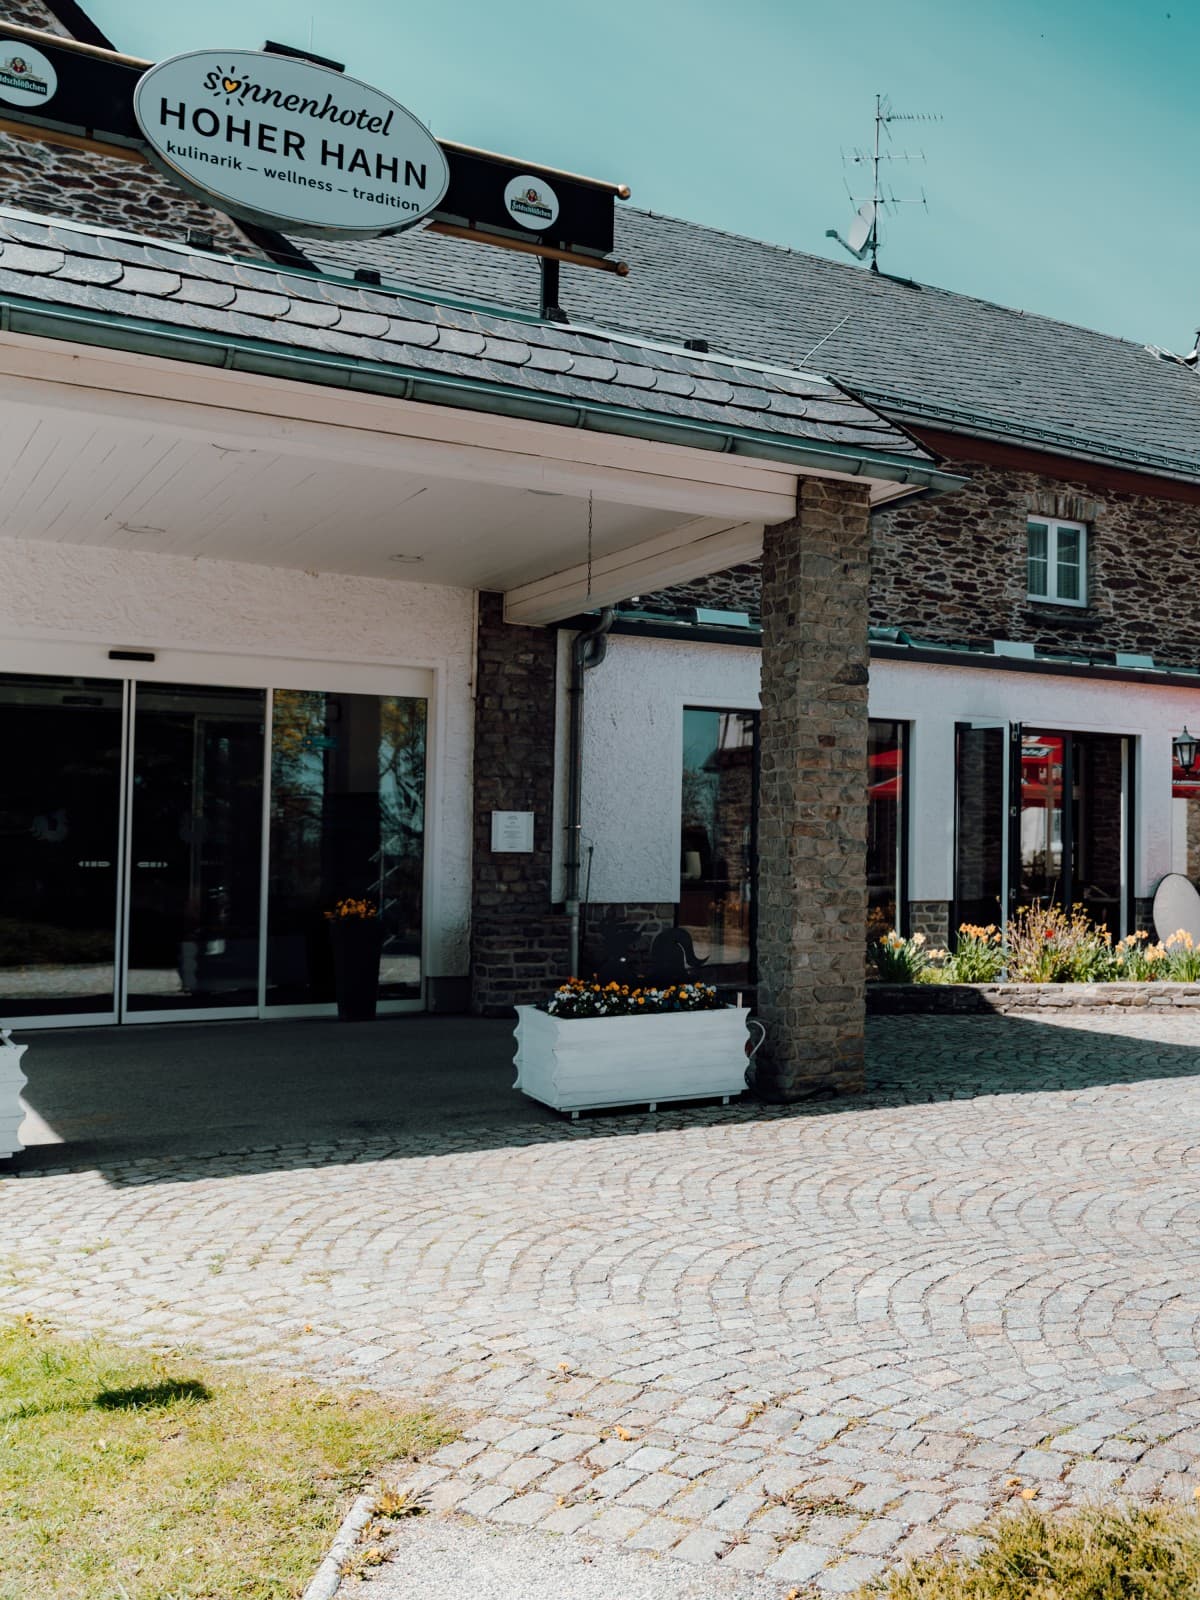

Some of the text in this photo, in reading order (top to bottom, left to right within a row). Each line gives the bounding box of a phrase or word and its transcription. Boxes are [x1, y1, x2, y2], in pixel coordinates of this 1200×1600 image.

[160, 97, 426, 190] HOHER HAHN
[166, 140, 243, 170] kulinarik
[263, 167, 333, 192] wellness
[352, 187, 420, 212] tradition
